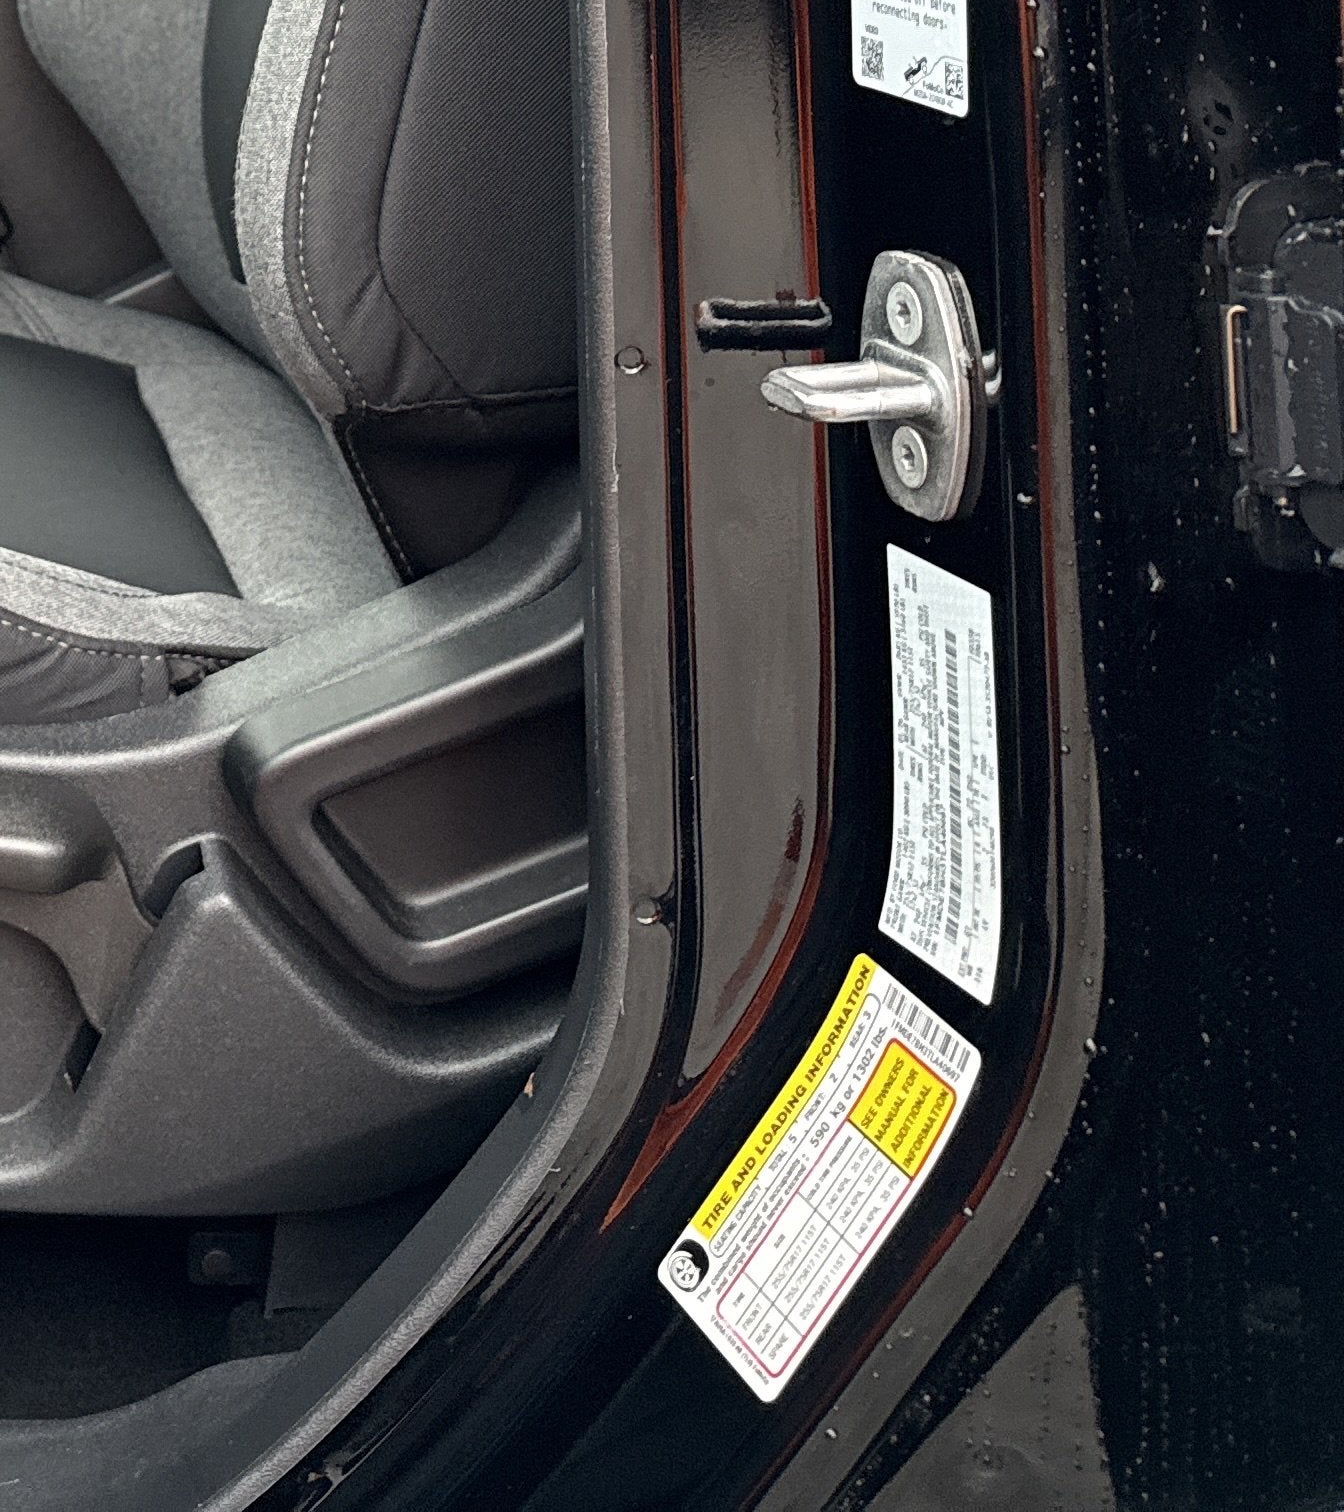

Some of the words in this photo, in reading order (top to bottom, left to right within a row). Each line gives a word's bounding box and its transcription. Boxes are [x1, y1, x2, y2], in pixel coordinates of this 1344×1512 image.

[701, 1189, 733, 1233] TIRE
[728, 1153, 757, 1194] AND
[754, 1081, 808, 1156] LOADING
[803, 963, 871, 1083] INFORMATION
[787, 1132, 797, 1144] 5
[828, 1071, 839, 1083] 2
[861, 1009, 872, 1021] 3
[808, 1119, 831, 1149] 590
[828, 1098, 847, 1121] kg
[841, 1083, 855, 1101] or
[850, 1046, 875, 1083] 1302
[859, 1105, 878, 1130] SEE
[873, 1092, 906, 1143] MANUAL
[900, 1066, 919, 1094] FOR
[888, 1081, 933, 1154] ADDITIONAL
[901, 1087, 950, 1169] INFORMATION
